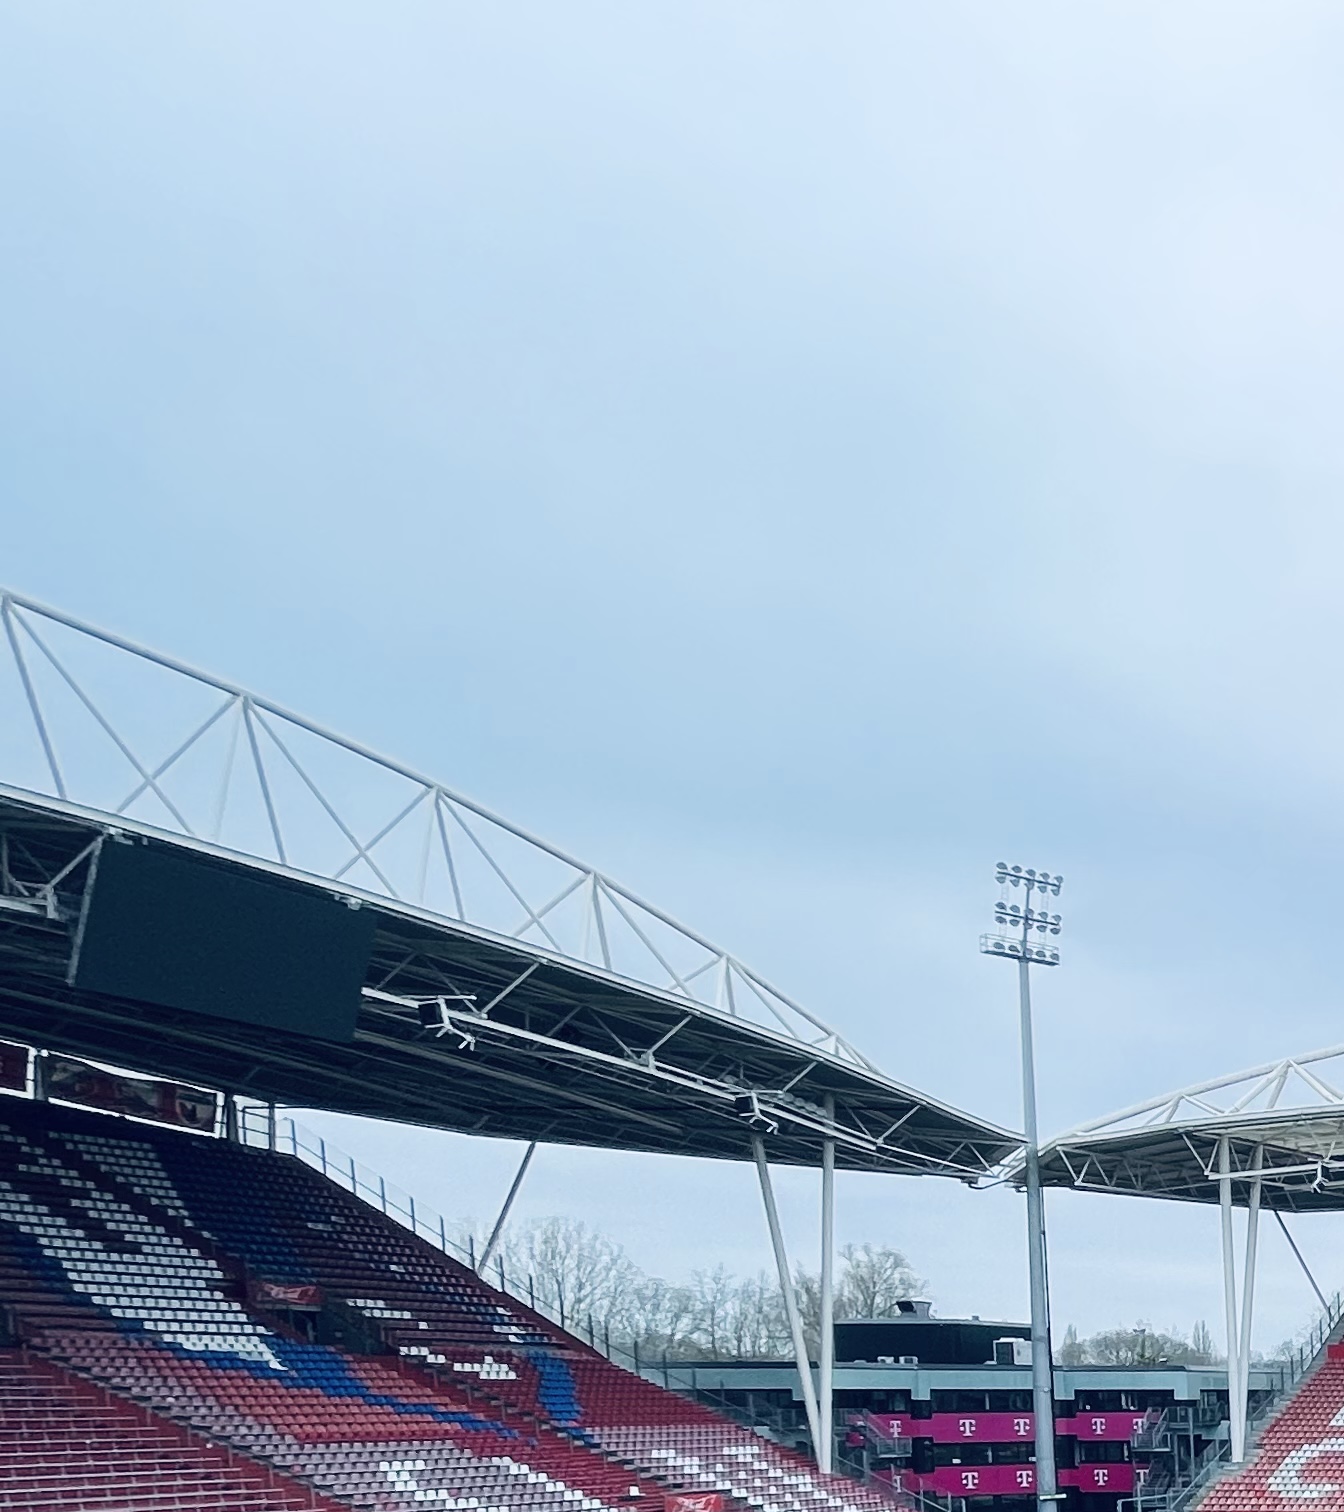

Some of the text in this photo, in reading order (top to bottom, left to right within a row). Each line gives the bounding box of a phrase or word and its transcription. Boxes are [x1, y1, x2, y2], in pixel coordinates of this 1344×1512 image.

[890, 1420, 902, 1437] T
[959, 1419, 976, 1437] T
[1014, 1418, 1030, 1436] T
[1092, 1418, 1106, 1435] T
[1133, 1418, 1147, 1434] T
[961, 1472, 979, 1489] T
[1016, 1470, 1033, 1488] T
[1094, 1469, 1108, 1486] T
[1135, 1469, 1149, 1484] T
